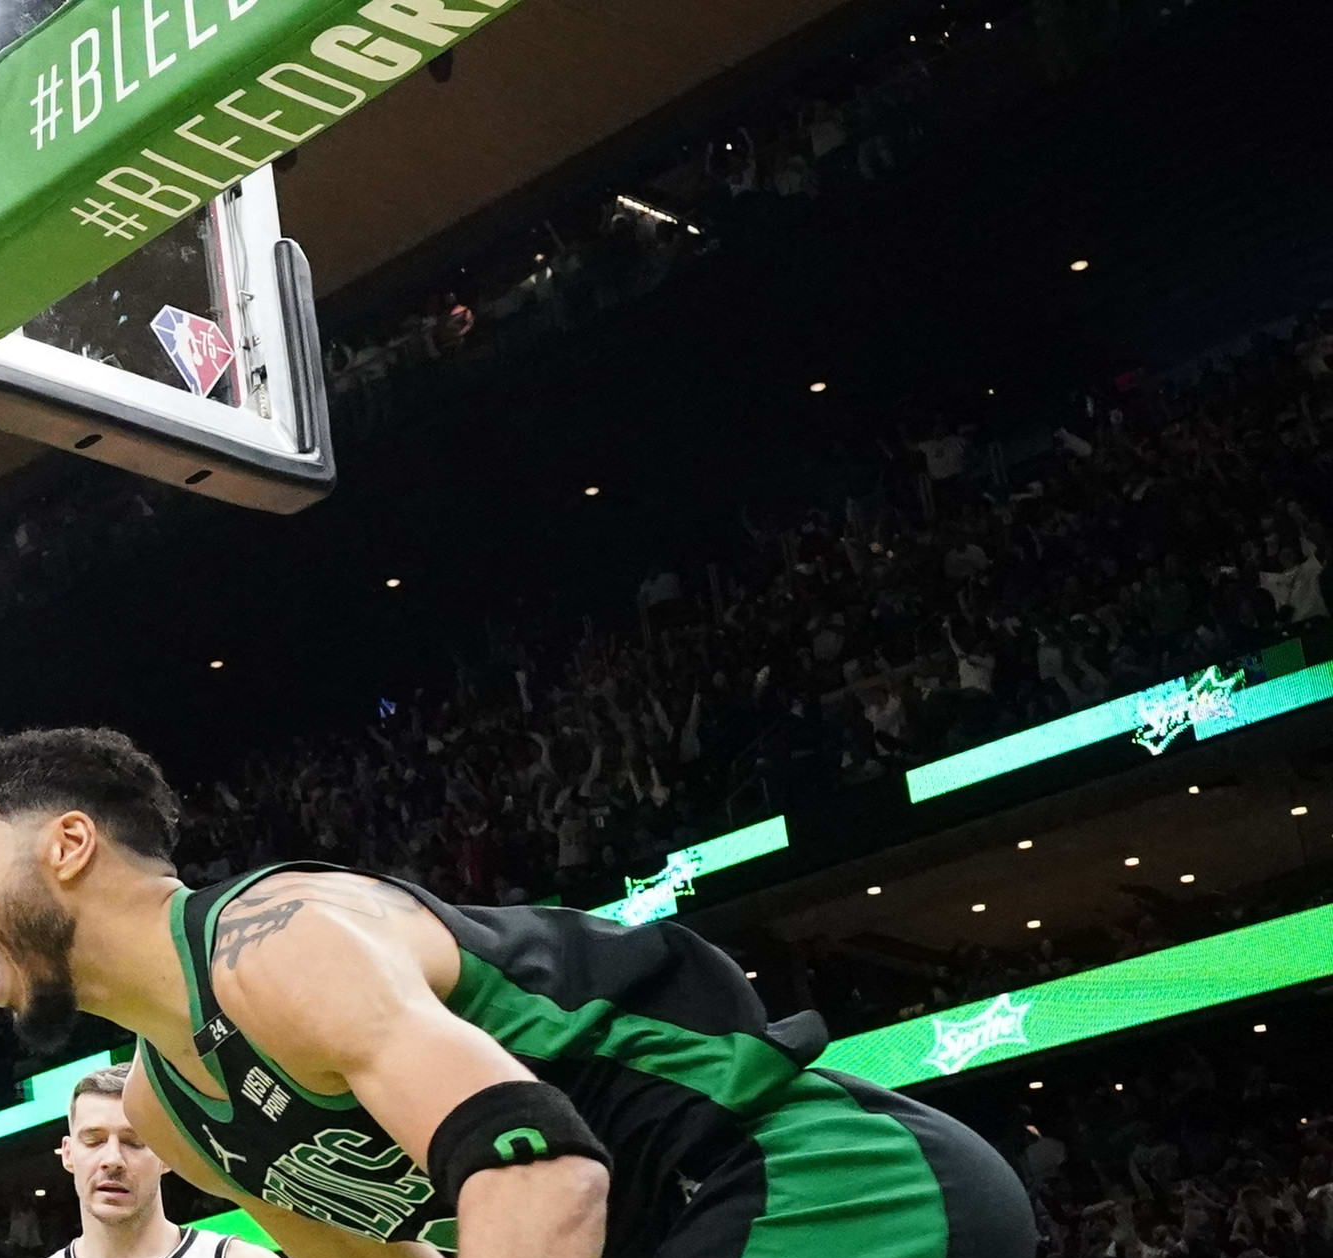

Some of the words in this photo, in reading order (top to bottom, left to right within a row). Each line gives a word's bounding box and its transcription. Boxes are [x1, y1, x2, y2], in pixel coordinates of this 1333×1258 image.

[209, 1018, 229, 1041] 24
[937, 1013, 1018, 1062] Sprite
[241, 1066, 275, 1106] VISTA
[261, 1084, 292, 1122] PRINT
